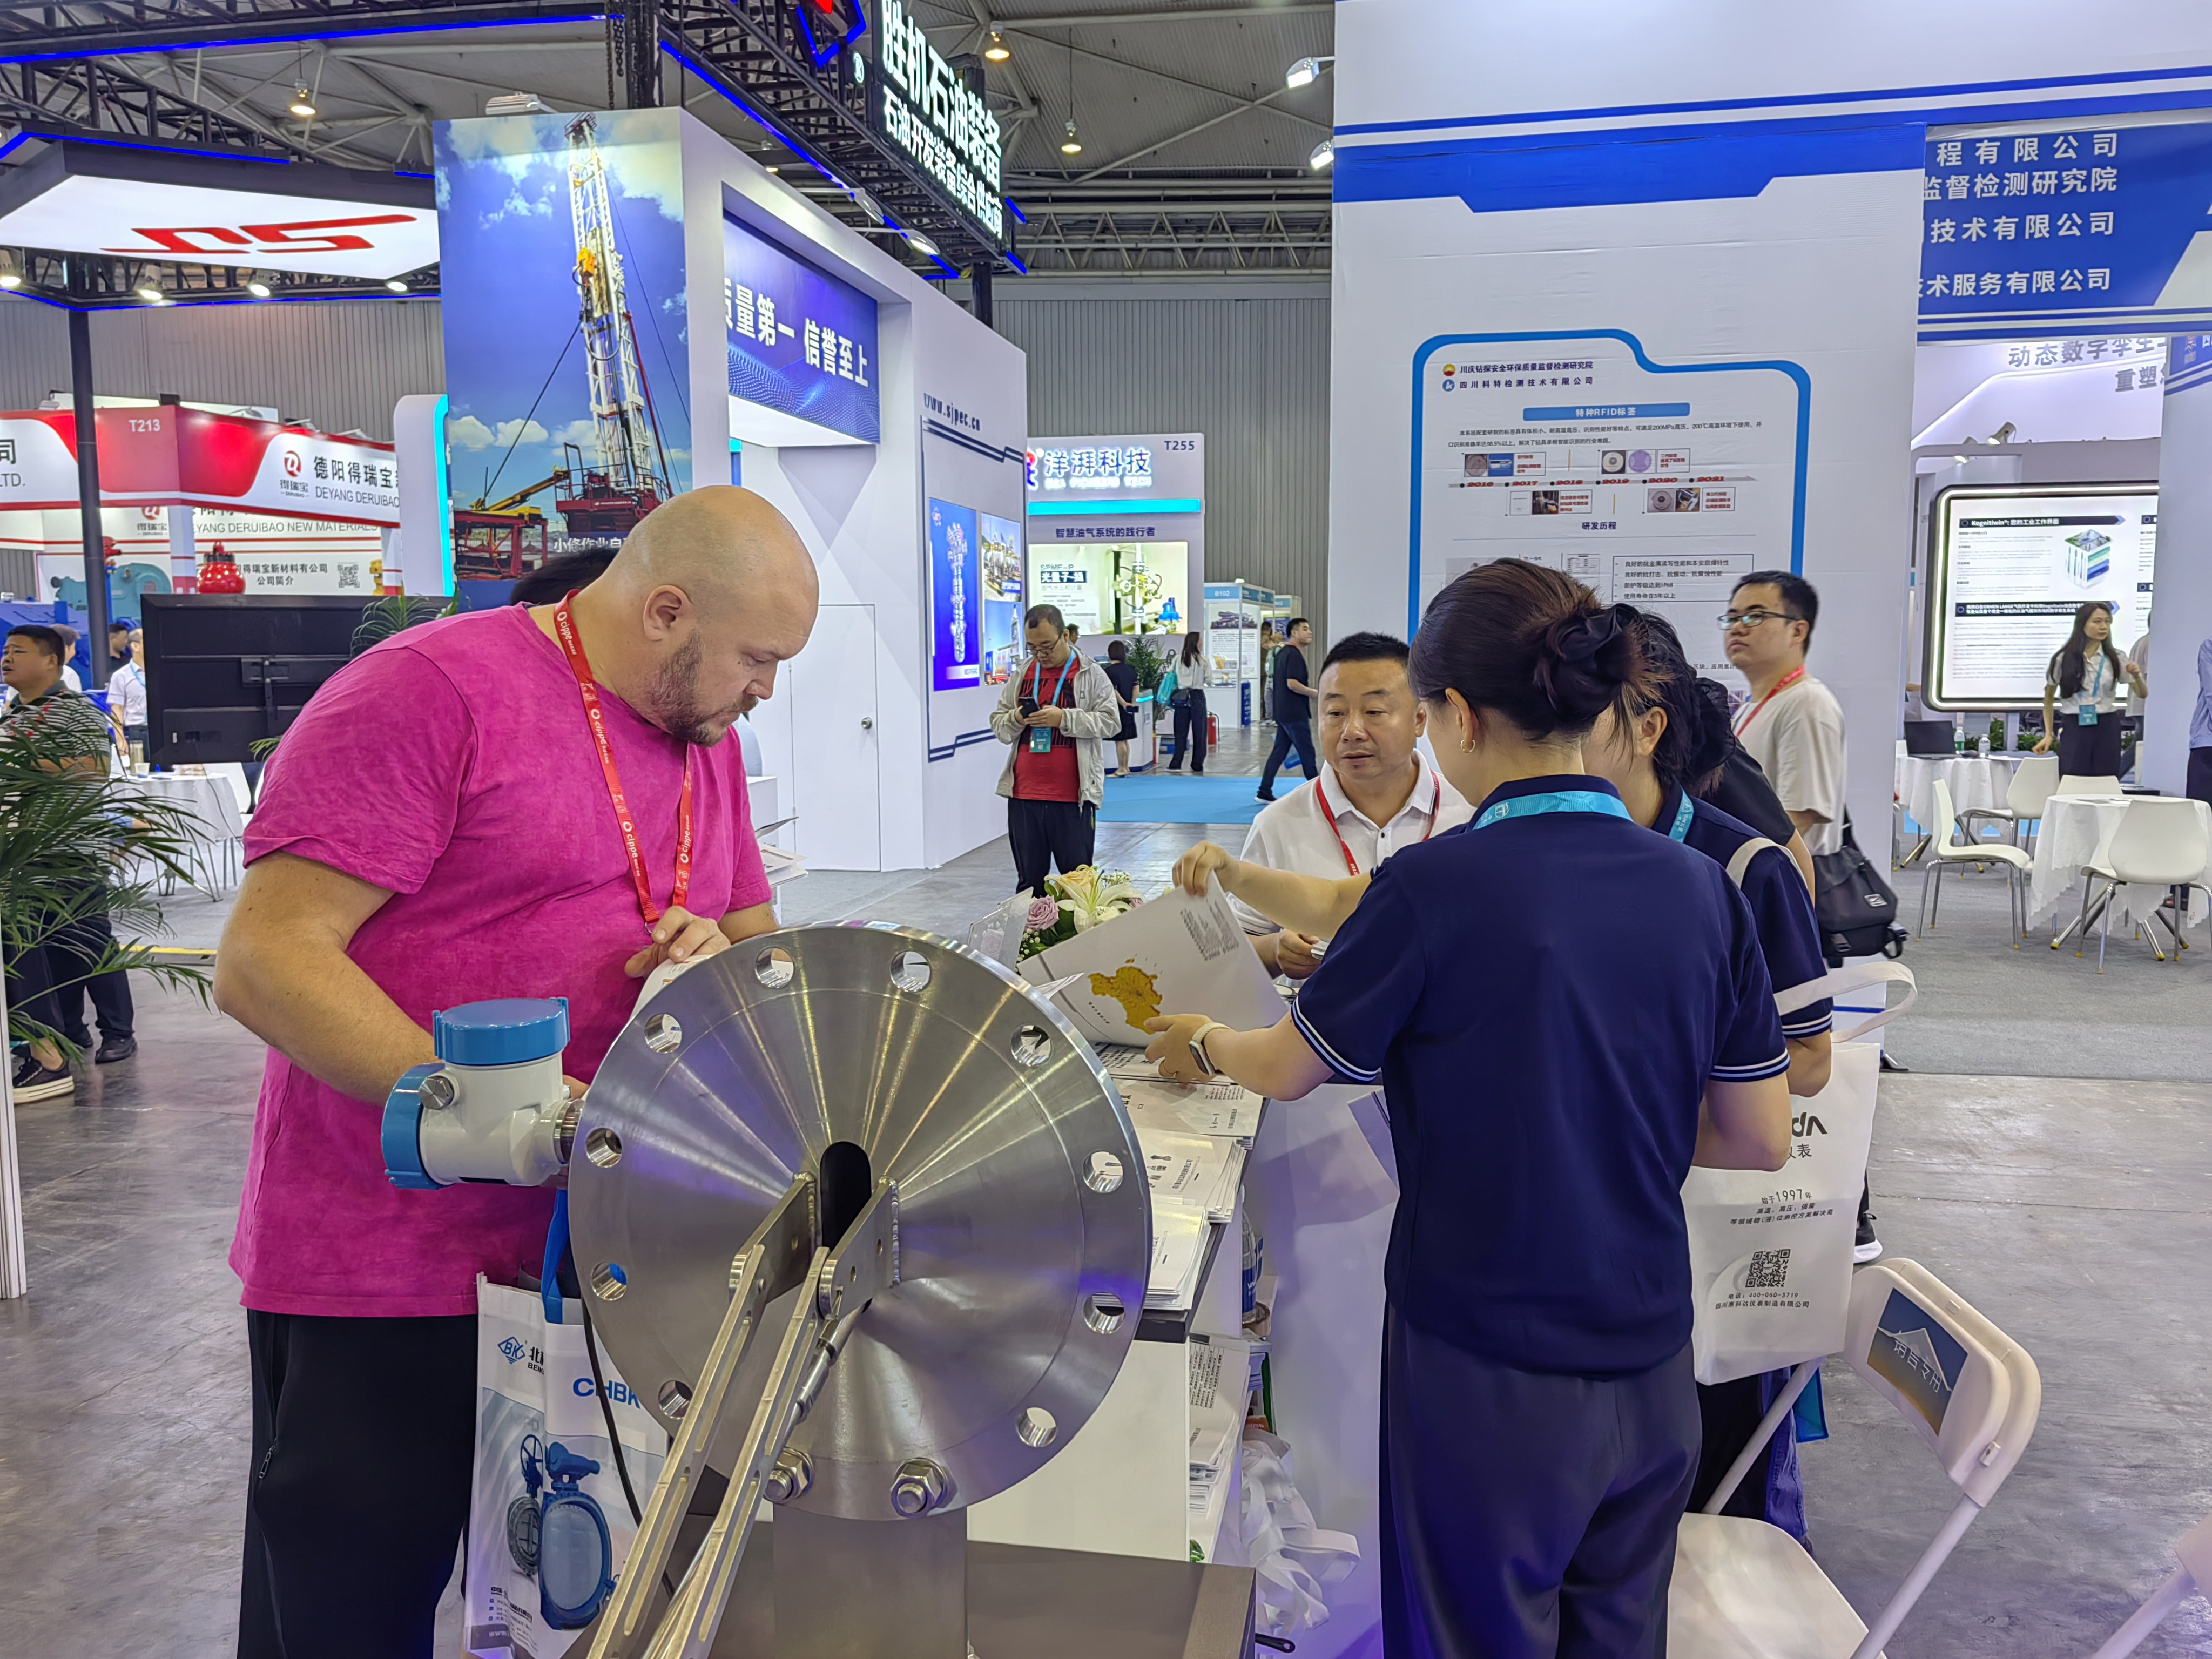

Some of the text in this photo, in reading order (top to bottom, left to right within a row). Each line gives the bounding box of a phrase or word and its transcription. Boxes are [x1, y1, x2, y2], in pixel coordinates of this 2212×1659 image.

[882, 0, 1002, 193] 胜机石油装备
[1937, 133, 2117, 166] 程有限公司
[883, 85, 1002, 239] 石油开发装备综合供应商
[1921, 212, 2114, 244] 技术有限公司
[1918, 268, 2110, 298] 术服务有限公司
[804, 318, 868, 387] 信誉至上
[1460, 361, 1594, 374] 川庆钻探安全环保质量监督检测研究院
[1460, 376, 1593, 389] 四川科特检测技术有限公司
[923, 393, 981, 431] www.sjpec.cn
[1575, 407, 1637, 417] 特种RFID标签
[129, 419, 161, 433] T213
[1164, 440, 1195, 451] T255
[314, 455, 399, 489] 德阳得瑞宝
[1044, 448, 1151, 476] 洋湃科技
[315, 486, 400, 508] DEYANG DERUIBAO
[228, 522, 285, 533] DERUIBAO
[287, 521, 314, 532] NEW
[1055, 527, 1156, 538] 智慧油气系统的践行者
[1581, 521, 1617, 531] 研发历程
[554, 537, 628, 553] 小修作业自
[257, 575, 294, 586] 公司简介
[560, 621, 573, 640] cippe
[595, 721, 607, 745] cippe
[626, 833, 638, 858] cippe
[682, 831, 692, 853] cippe
[1761, 1189, 1812, 1205] 始于1997年
[527, 1362, 545, 1375] BEIK
[572, 1378, 641, 1410] CHBK
